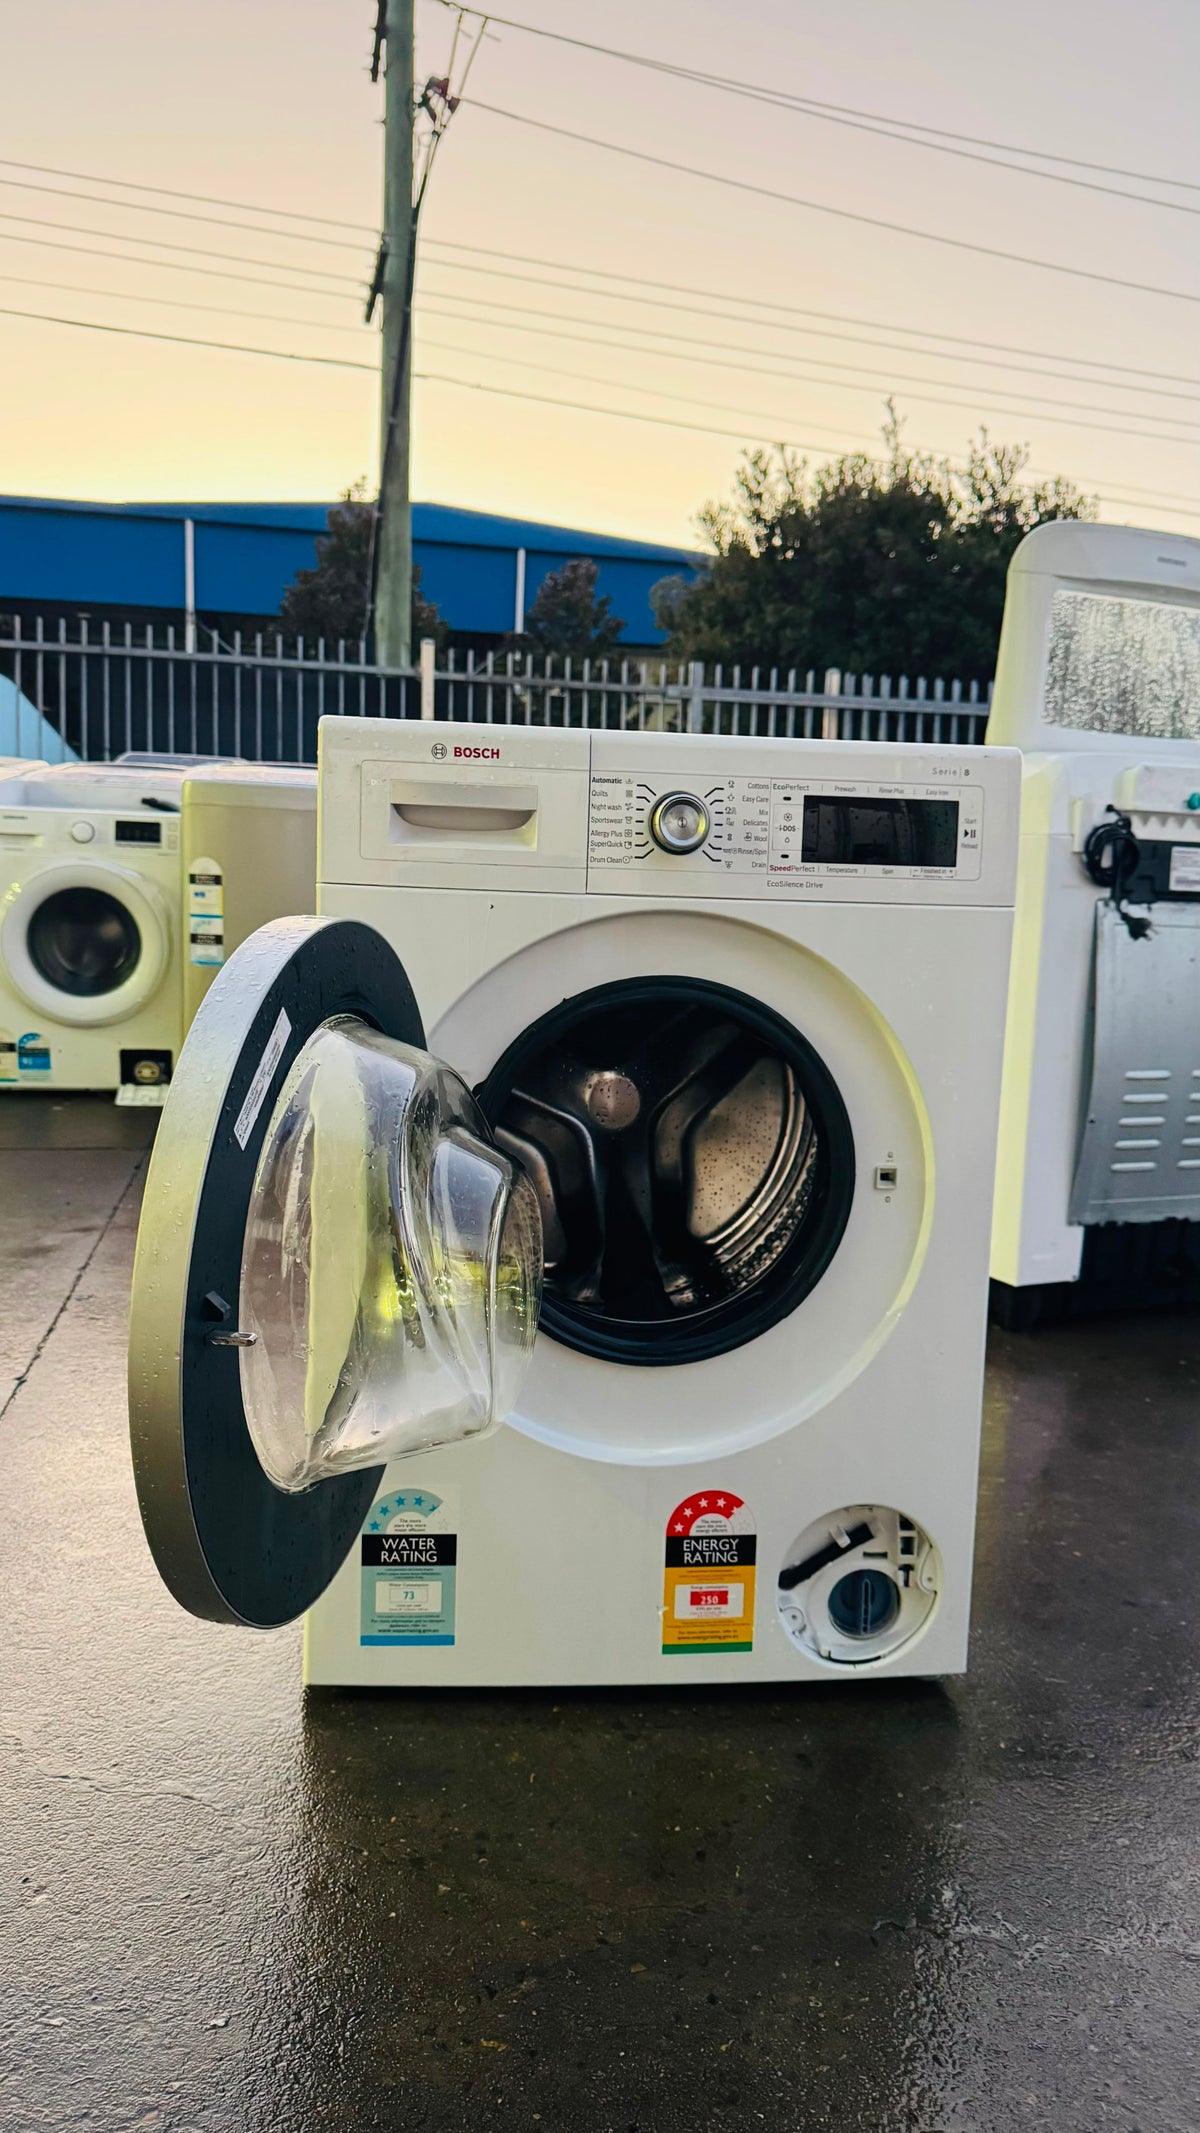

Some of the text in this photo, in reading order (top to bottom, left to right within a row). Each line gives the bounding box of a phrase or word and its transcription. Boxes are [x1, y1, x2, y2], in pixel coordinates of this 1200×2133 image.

[454, 746, 500, 759] BOSCH
[932, 767, 957, 776] Serie
[773, 783, 809, 791] EcoPerfect
[742, 795, 755, 803] Easy
[591, 803, 607, 811] Night
[590, 816, 623, 824] Sportswear
[743, 819, 769, 827] Delicates
[590, 830, 610, 838] Allergy
[590, 840, 623, 848] SuperQuick
[769, 865, 815, 873] SpeedPerfect
[826, 866, 858, 874] Temperature
[767, 880, 804, 888] EcoSilence
[382, 1538, 436, 1550] WATER
[683, 1538, 739, 1551] ENERGY
[381, 1551, 438, 1562] RATING
[684, 1551, 738, 1564] RATING
[403, 1590, 415, 1600] 73
[700, 1595, 719, 1605] 250
